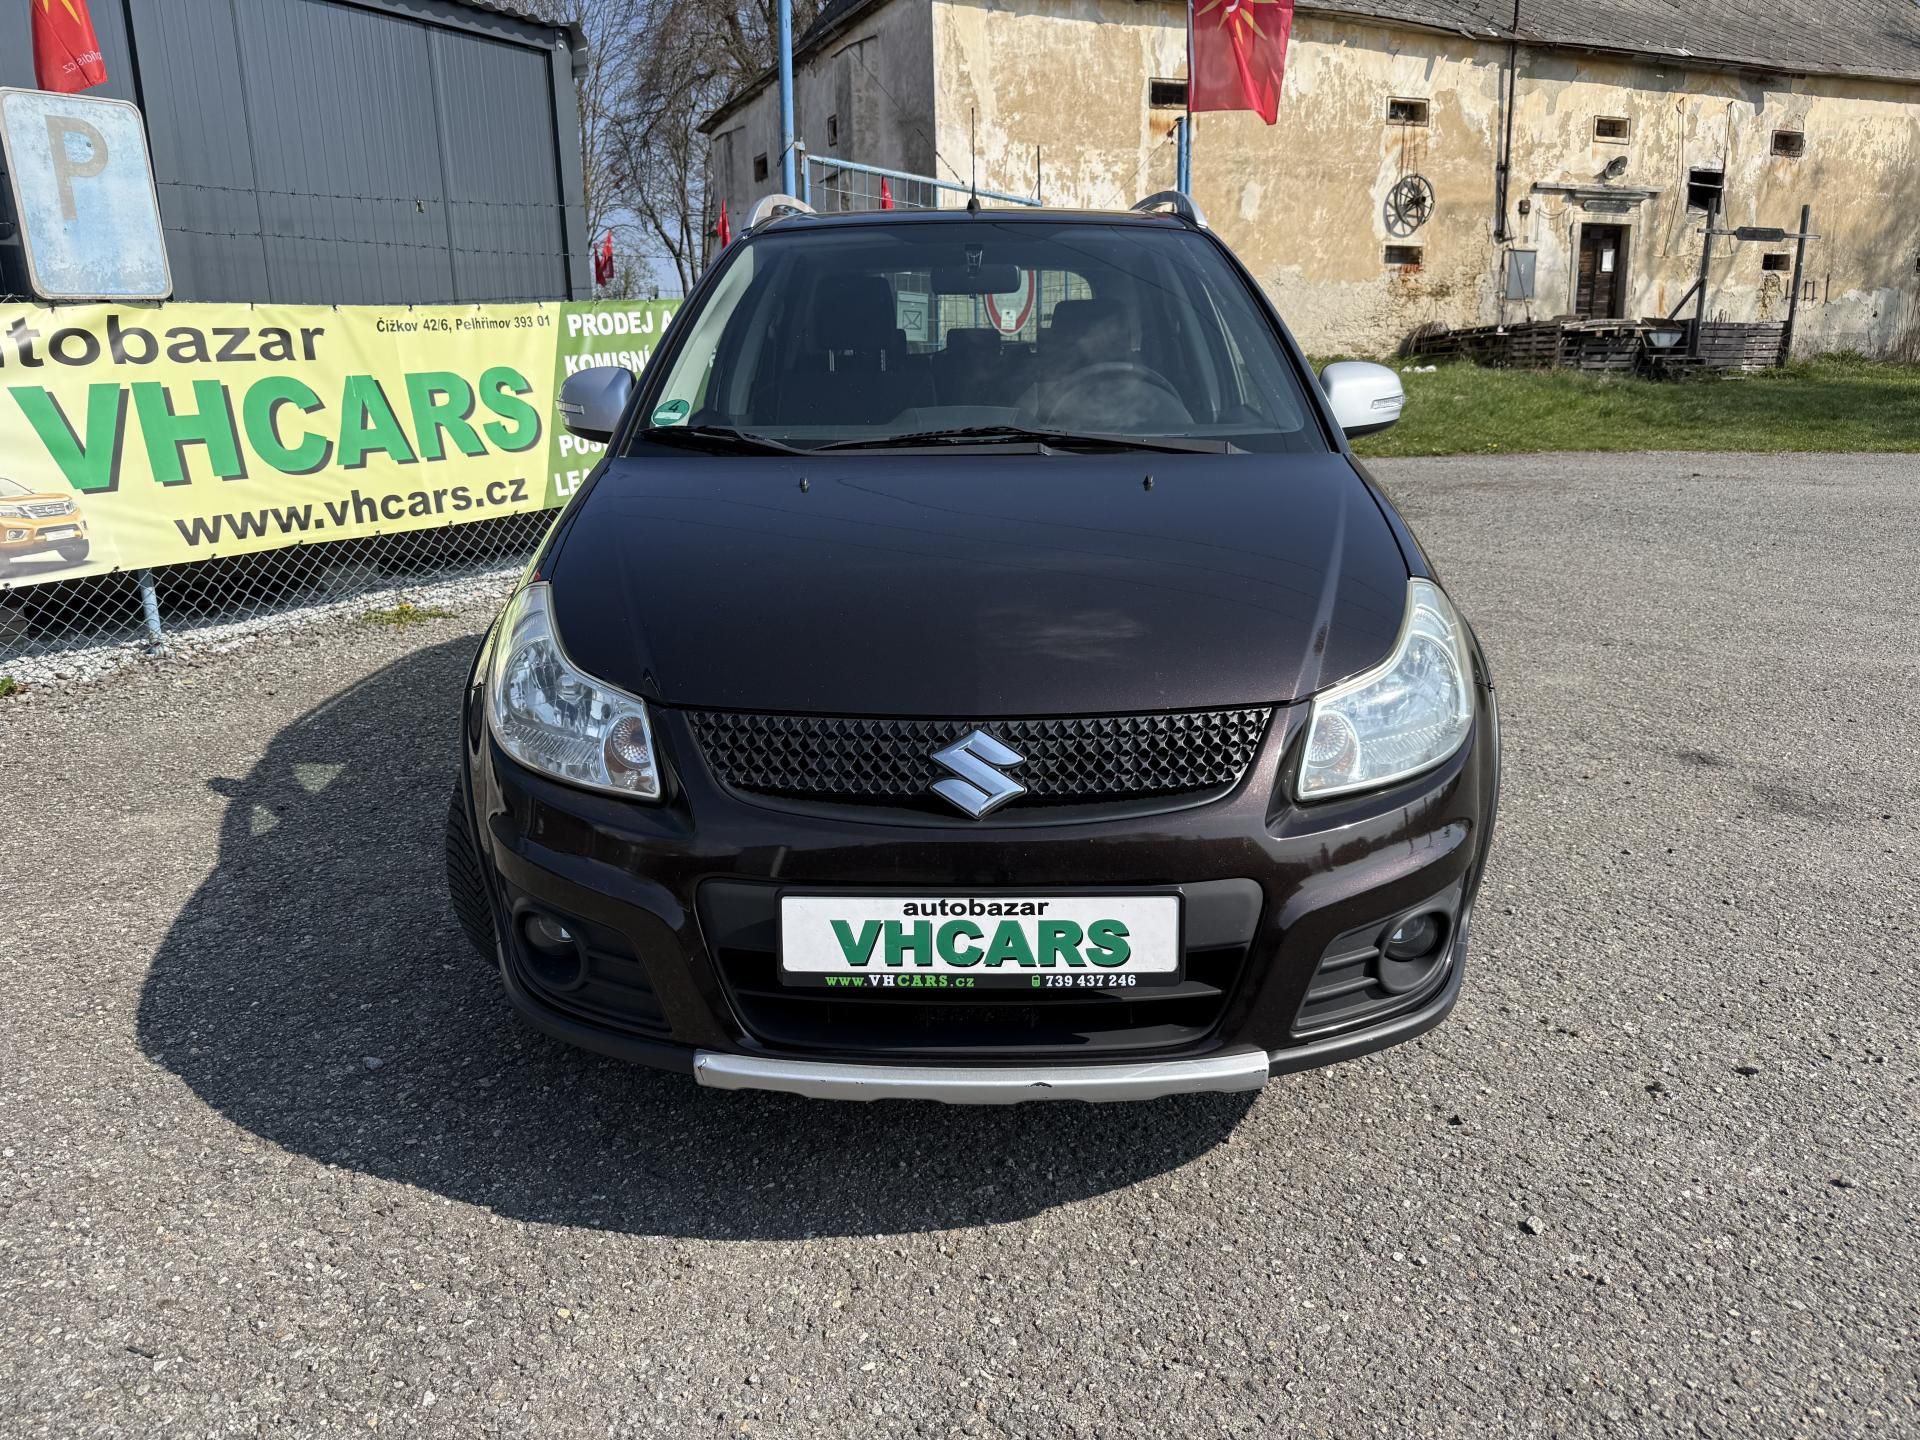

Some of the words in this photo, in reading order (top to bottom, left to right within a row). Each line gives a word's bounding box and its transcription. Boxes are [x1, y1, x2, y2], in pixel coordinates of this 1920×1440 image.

[44, 115, 109, 221] P
[423, 318, 452, 333] 42/6,
[455, 318, 511, 331] Pelhřimov
[514, 316, 534, 329] 393
[537, 315, 551, 327] 01
[567, 311, 653, 337] PRODEJ
[0, 314, 325, 367] tobazar
[669, 401, 681, 412] 4
[7, 366, 542, 495] VHCARS
[174, 478, 529, 546] www.vhcars.cz
[903, 899, 1049, 917] autobazar
[830, 919, 1132, 967] VHCARS
[825, 975, 975, 988] www.VHCARS.cz
[1046, 975, 1073, 987] 739
[1077, 975, 1104, 987] 437
[1108, 975, 1136, 987] 246
